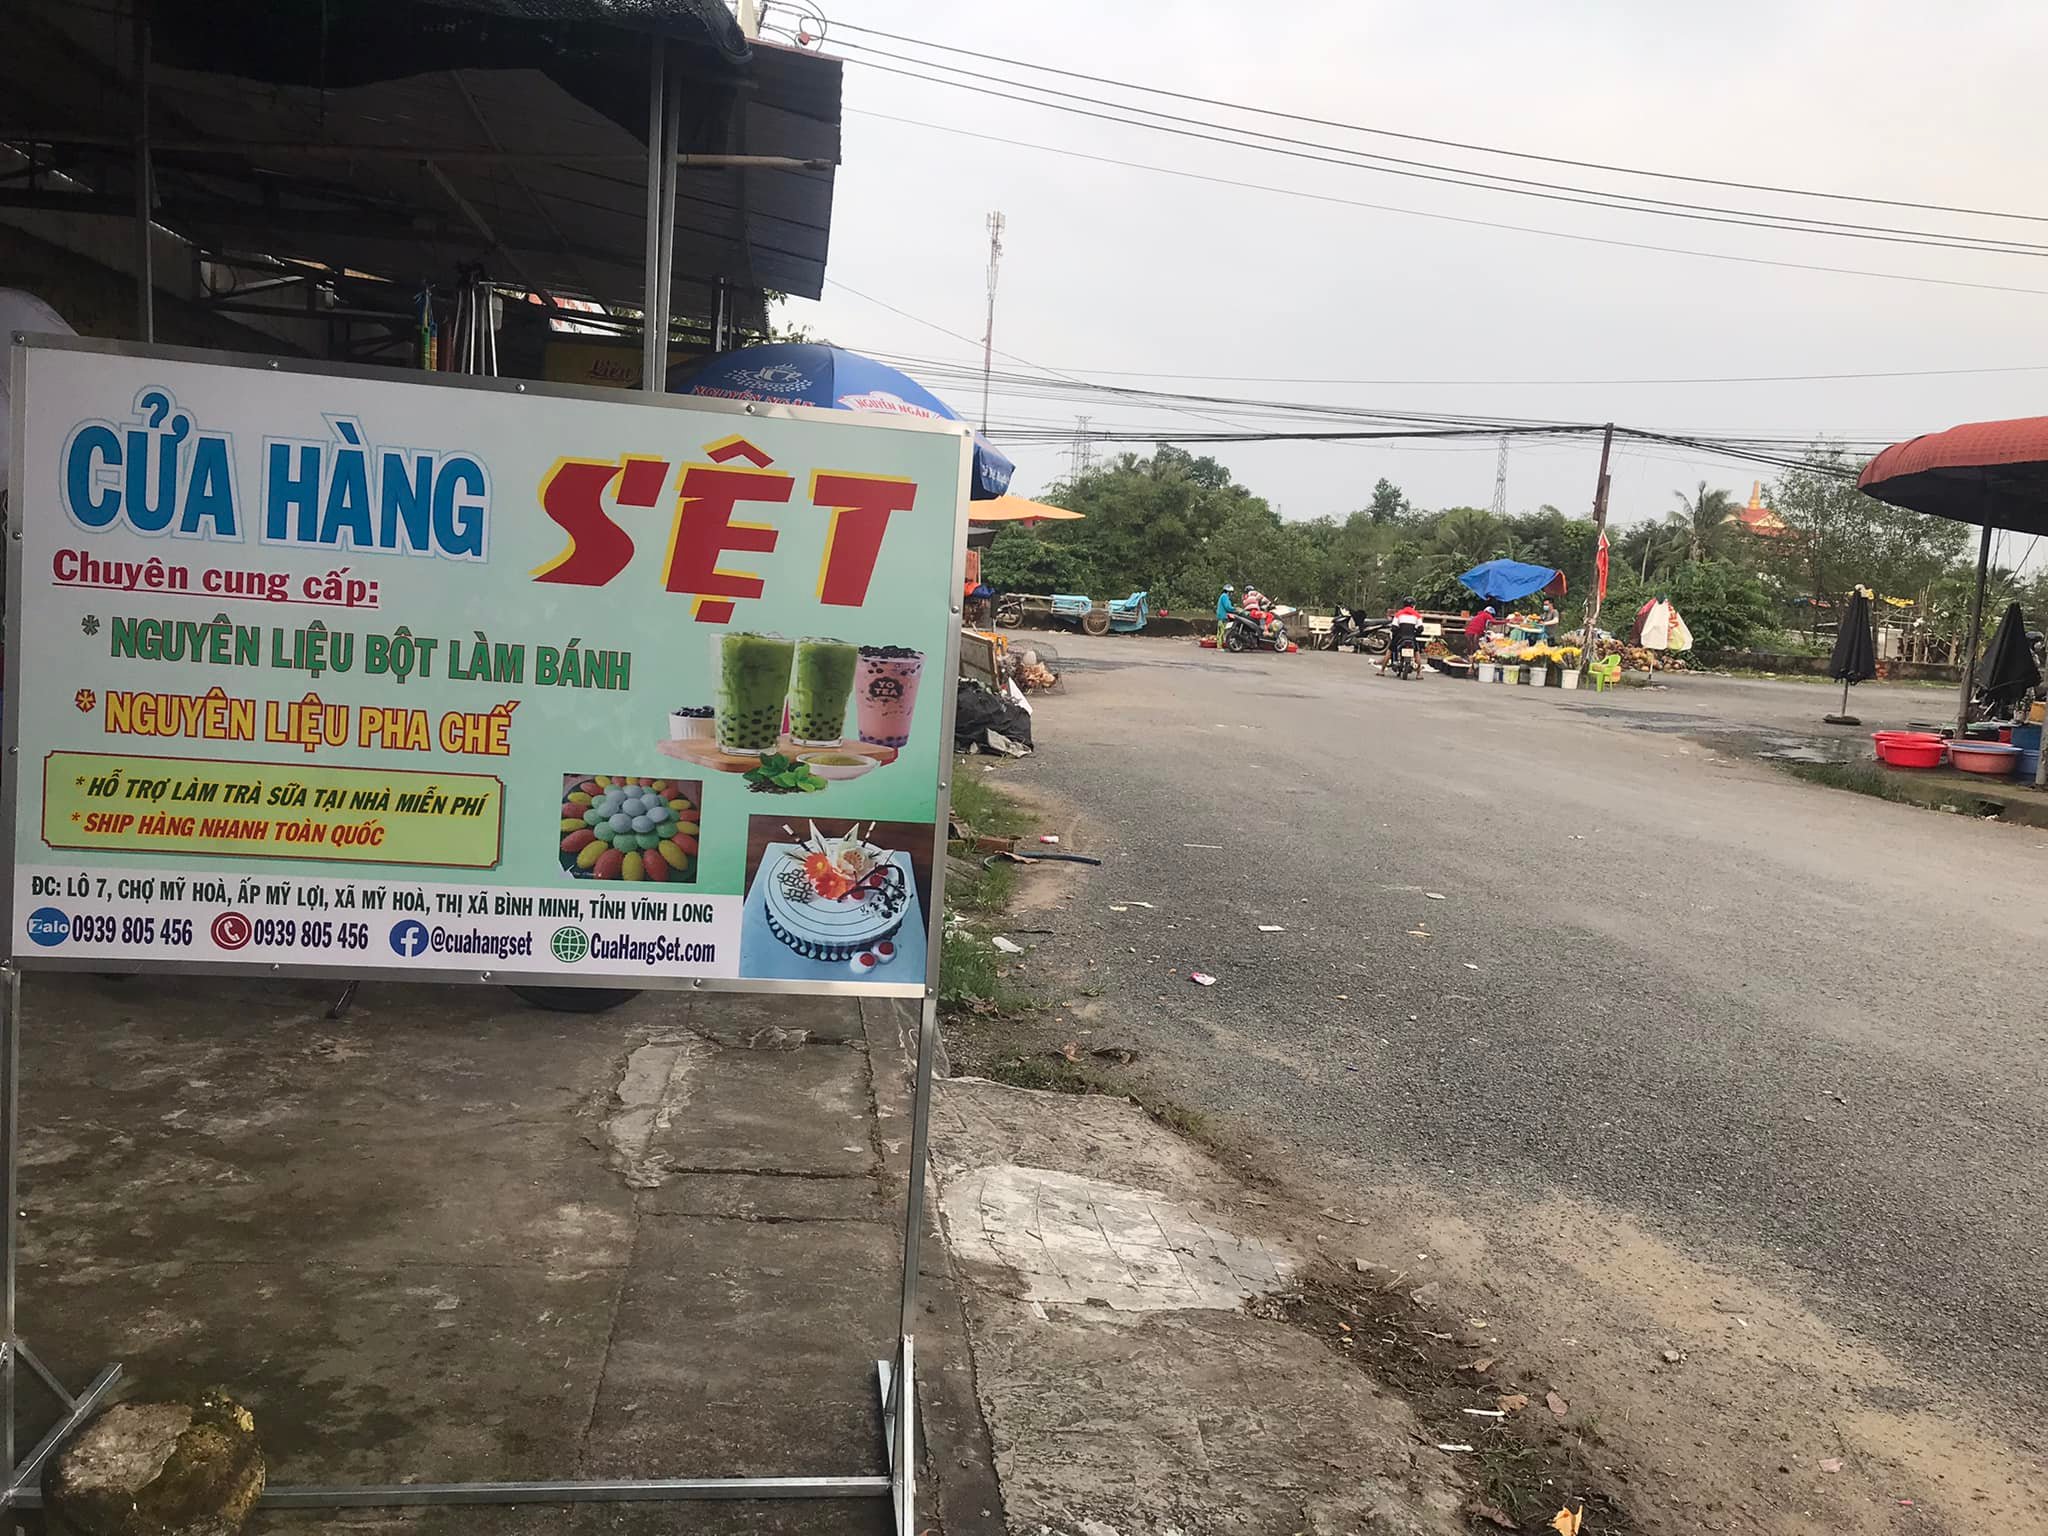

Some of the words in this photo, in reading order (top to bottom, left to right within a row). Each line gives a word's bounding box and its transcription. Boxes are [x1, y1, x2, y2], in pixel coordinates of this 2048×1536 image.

[67, 391, 237, 536] CỬA
[266, 421, 486, 557] HÀNG
[52, 549, 188, 592] Chuyên
[202, 569, 290, 601] cung
[302, 567, 379, 606] cấp:
[110, 613, 260, 666] NGUYÊN
[272, 620, 354, 678] LIỆU
[365, 626, 438, 684] BỘT
[448, 630, 525, 684] LÀM
[535, 638, 632, 691] BÁNH
[874, 688, 898, 697] TEA
[878, 680, 896, 689] YO
[104, 686, 256, 741] NGUYÊN
[265, 692, 350, 753] LIỆU
[358, 706, 431, 751] PHA
[439, 700, 520, 756] CHẾ
[87, 769, 122, 798] HỖ
[125, 778, 171, 804] TRỢ
[171, 777, 219, 803] LÀM
[223, 780, 262, 805] TRÀ
[267, 782, 308, 808] SỮA
[313, 788, 347, 813] TẠI
[350, 787, 391, 812] NHÀ
[395, 785, 449, 815] MIỄN
[450, 792, 490, 817] PHÍ
[83, 813, 134, 834] SHIP
[137, 811, 196, 837] HÀNG
[199, 818, 268, 840] NHANH
[275, 818, 327, 843] TOÀN
[330, 819, 385, 847] QUỐC
[31, 876, 61, 897] ĐC:
[67, 872, 90, 898] LÔ
[96, 878, 112, 903] 7,
[118, 878, 155, 904] CHỢ
[160, 876, 186, 901] MỸ
[192, 878, 232, 907] HOÀ,
[237, 876, 261, 904] ẤP
[266, 881, 291, 906] MỸ
[297, 884, 329, 912] LỢI,
[334, 885, 356, 909] XÃ
[362, 886, 386, 910] MỸ
[392, 887, 431, 916] HOÀ,
[436, 893, 463, 918] THỊ
[468, 891, 489, 915] XÃ
[494, 892, 533, 917] BÌNH
[538, 898, 584, 922] MINH,
[589, 893, 626, 920] TỈNH
[631, 897, 667, 922] VĨNH
[672, 903, 714, 924] LONG
[29, 918, 69, 934] Zalo
[72, 914, 117, 944] 0939
[121, 916, 155, 945] 805
[160, 918, 193, 946] 456
[253, 918, 297, 947] 0939
[300, 920, 333, 949] 805
[337, 922, 369, 950] 456
[430, 925, 533, 960] @cuahangset
[590, 932, 715, 966] CuaHangSet.com
